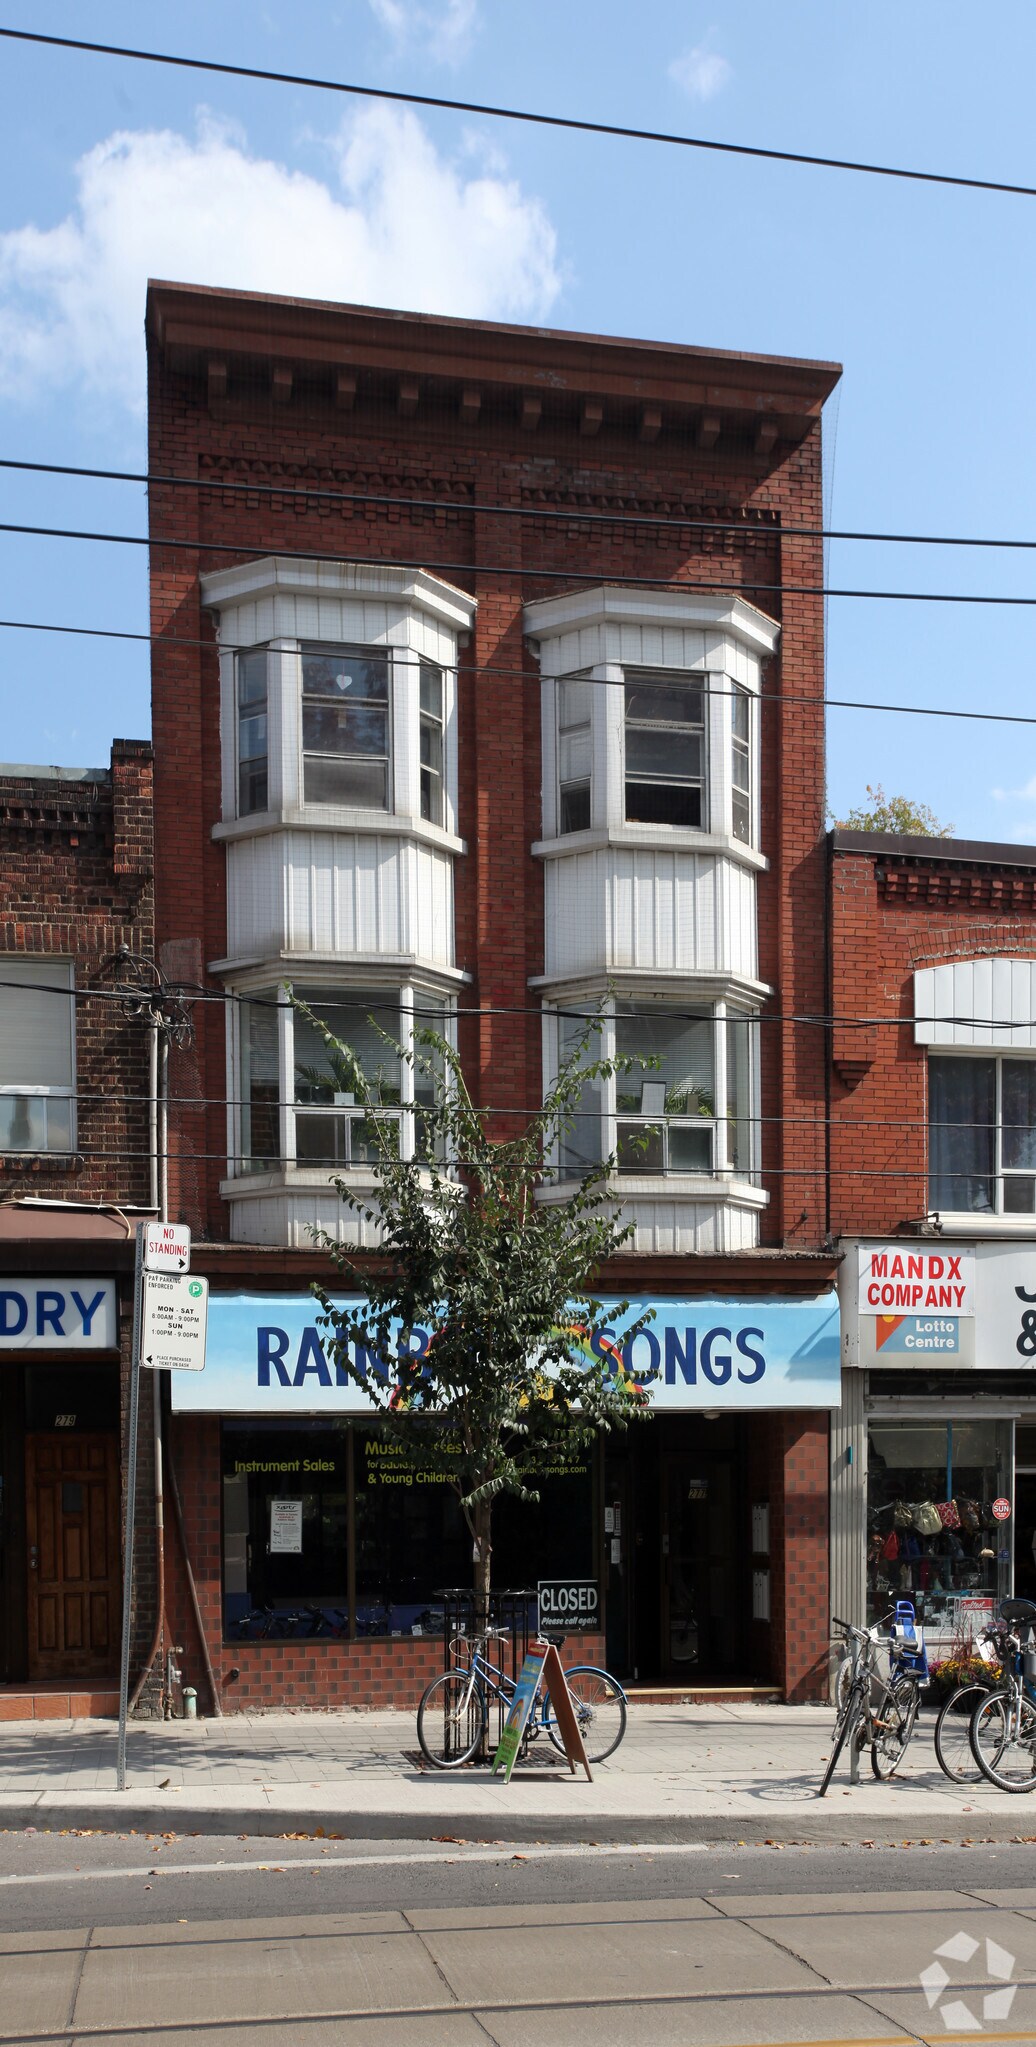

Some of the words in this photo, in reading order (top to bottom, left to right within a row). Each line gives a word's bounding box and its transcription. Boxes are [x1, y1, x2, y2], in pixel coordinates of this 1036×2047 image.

[163, 1228, 174, 1239] NO
[149, 1242, 188, 1256] STANDING
[871, 1254, 962, 1280] MANDX
[148, 1282, 173, 1290] ENFORCED
[160, 1276, 181, 1284] PARKING
[867, 1282, 967, 1308] COMPANY
[0, 1291, 106, 1336] DRY
[915, 1319, 955, 1332] Lotto
[904, 1334, 955, 1348] Centre
[590, 1326, 766, 1386] SONGS
[56, 1415, 76, 1426] 279
[234, 1460, 299, 1473] Instrument
[303, 1458, 335, 1472] Sales
[367, 1473, 376, 1484] &
[379, 1473, 412, 1486] Young
[416, 1472, 459, 1483] Children
[993, 1505, 1009, 1513] SUN
[541, 1588, 598, 1611] CLOSED
[541, 1617, 564, 1625] Please
[564, 1616, 578, 1624] call
[578, 1616, 598, 1626] again
